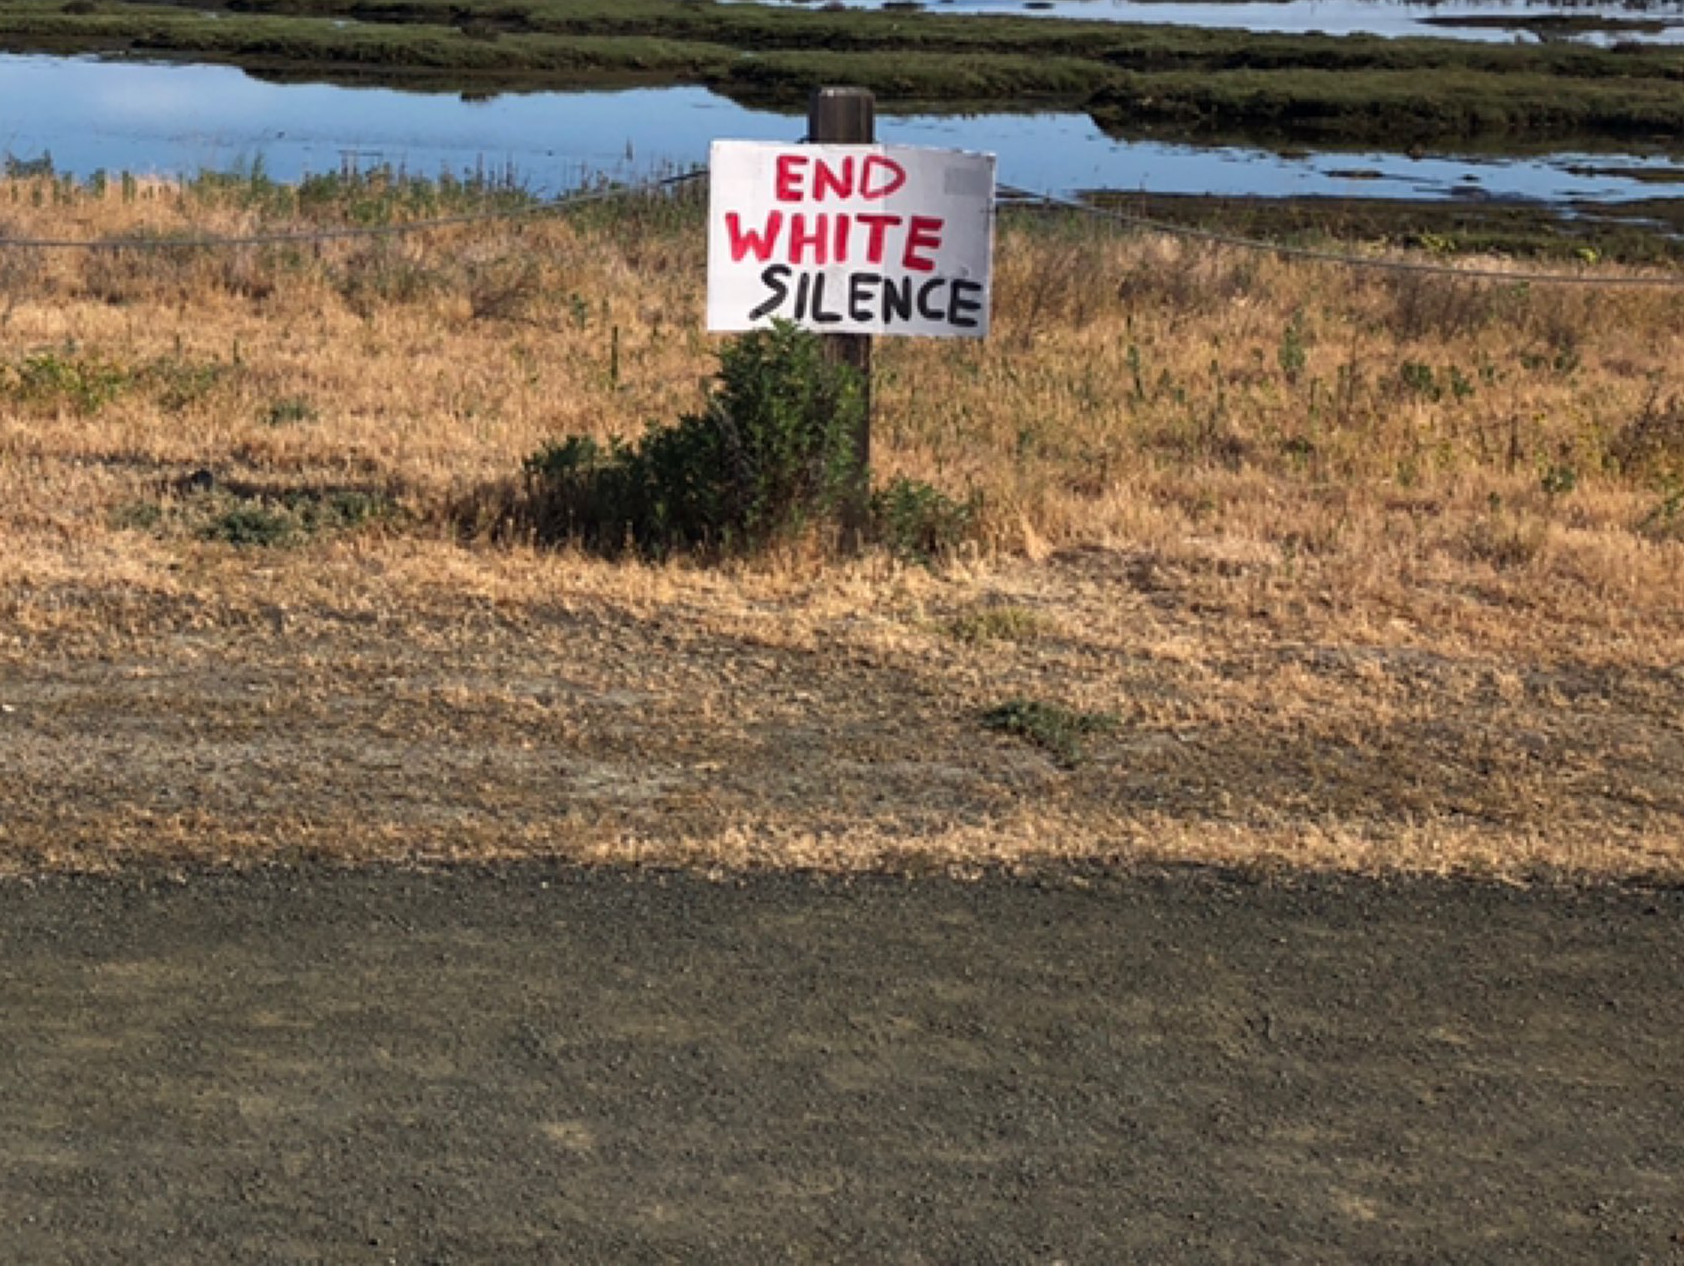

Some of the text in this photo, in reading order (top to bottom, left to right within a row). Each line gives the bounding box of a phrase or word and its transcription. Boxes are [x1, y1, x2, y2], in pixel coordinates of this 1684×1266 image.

[776, 155, 906, 201] END
[725, 210, 945, 273] WHITE
[749, 264, 983, 327] SILENCE
